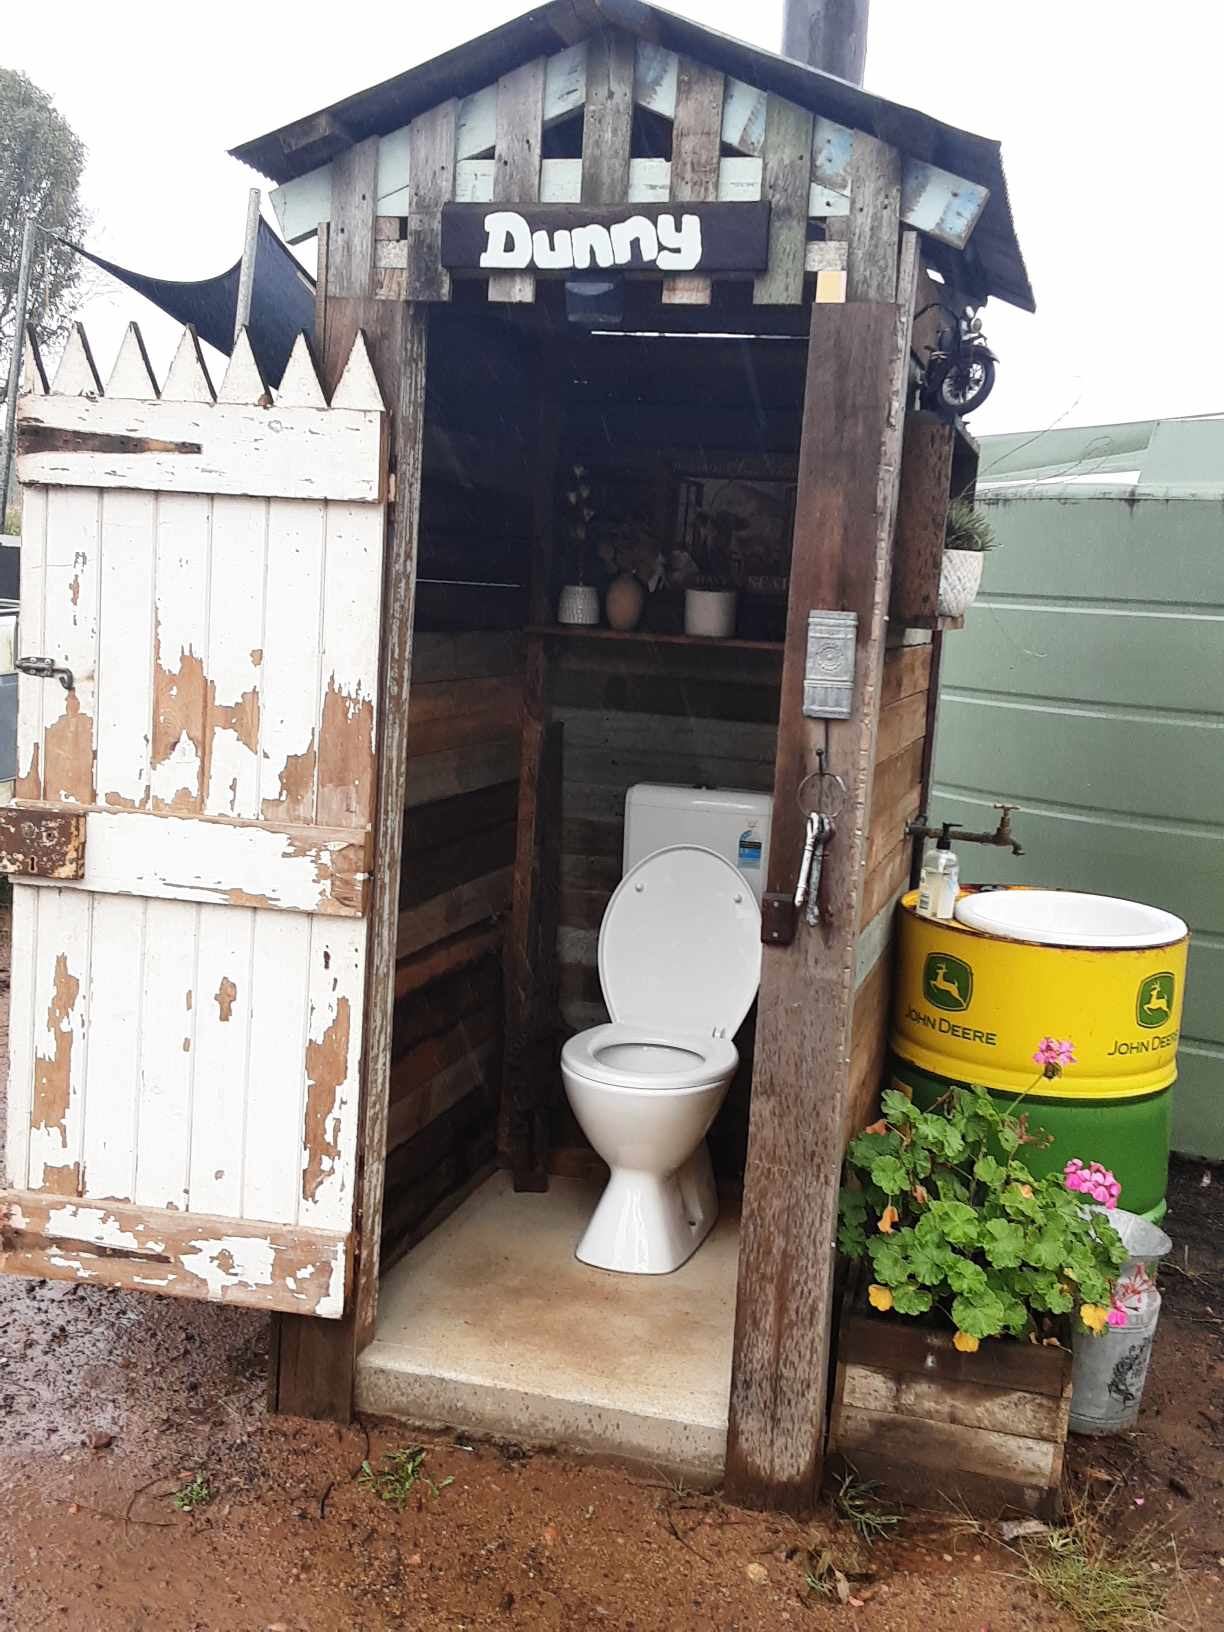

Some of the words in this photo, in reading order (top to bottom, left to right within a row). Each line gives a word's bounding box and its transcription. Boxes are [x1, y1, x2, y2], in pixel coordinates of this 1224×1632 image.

[480, 211, 702, 271] Dunny
[905, 1006, 936, 1030] JOHN
[938, 1017, 998, 1046] DEERE
[1107, 1040, 1149, 1056] JOHN
